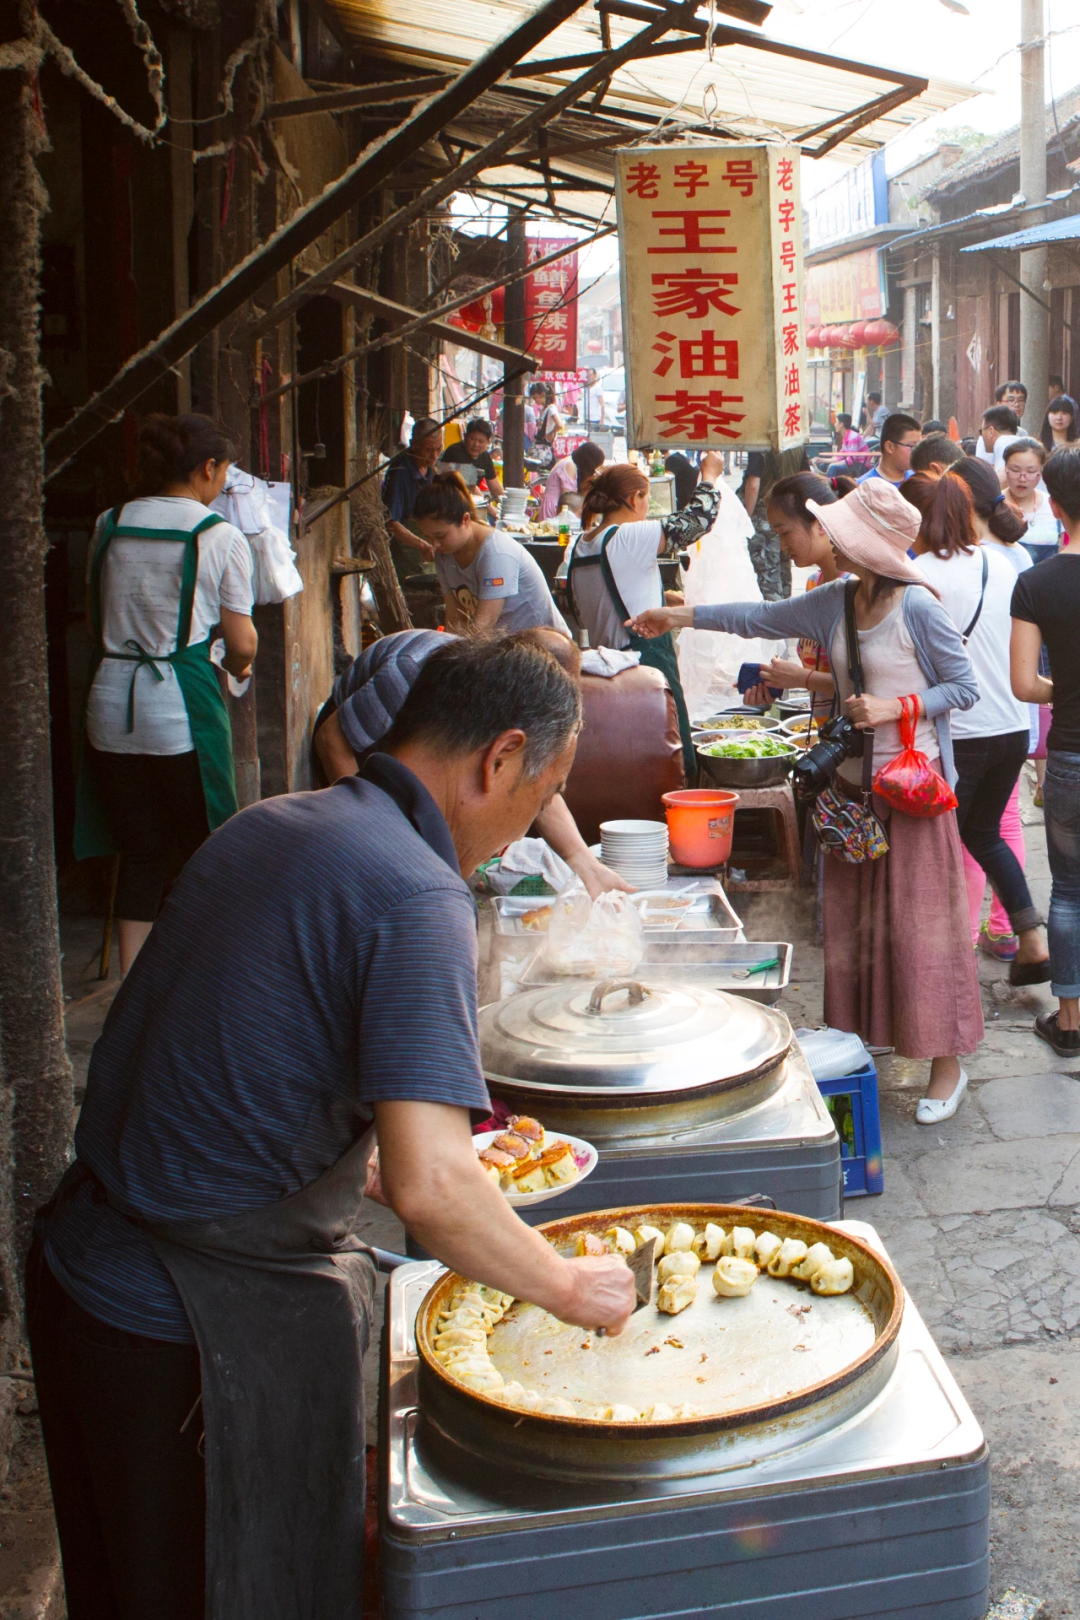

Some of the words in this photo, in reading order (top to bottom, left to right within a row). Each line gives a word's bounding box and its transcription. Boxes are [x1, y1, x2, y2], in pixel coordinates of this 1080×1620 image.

[626, 160, 758, 199] 老字号
[532, 269, 570, 352] 鳝鱼辣汤
[647, 210, 747, 440] 王家油茶
[776, 157, 801, 438] 老字号王家油茶
